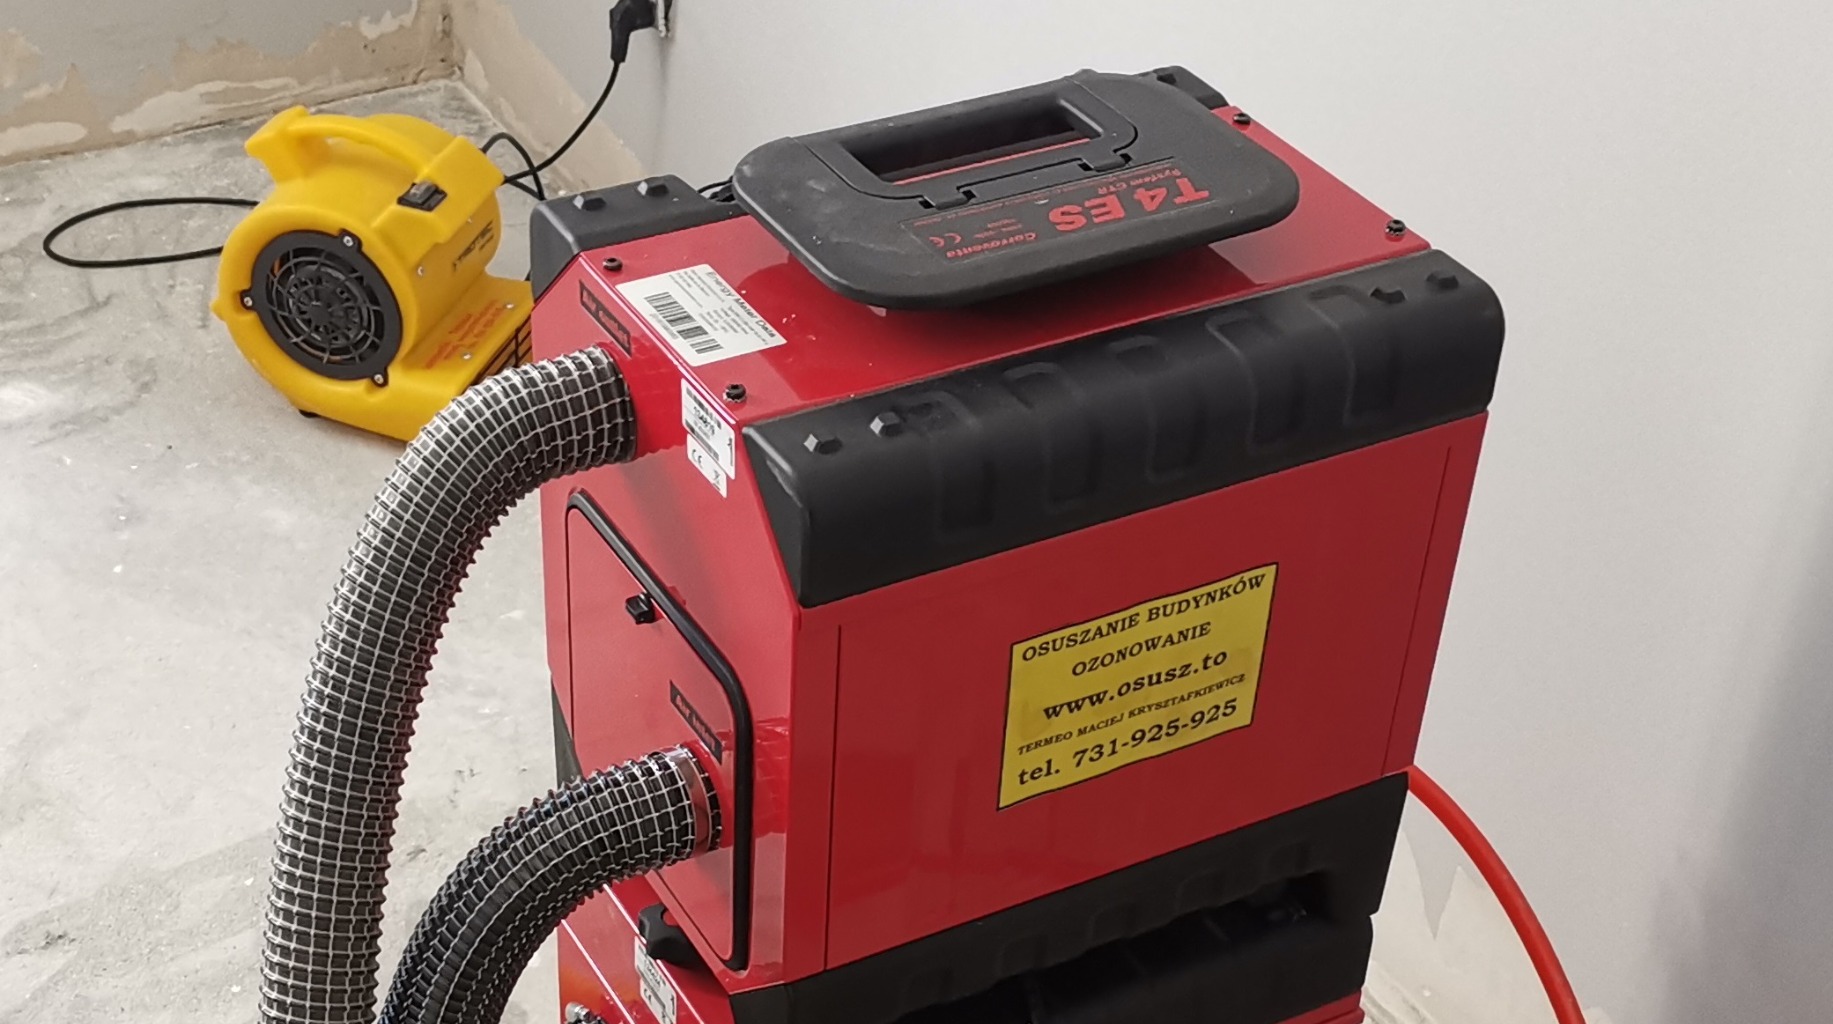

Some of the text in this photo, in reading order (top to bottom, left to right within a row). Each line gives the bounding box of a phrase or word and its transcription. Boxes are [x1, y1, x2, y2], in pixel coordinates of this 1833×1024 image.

[1048, 193, 1127, 232] ES
[1133, 177, 1211, 213] T4
[946, 231, 1037, 258] Corroventa
[705, 271, 735, 297] Energy
[755, 320, 776, 337] Data
[1021, 573, 1266, 662] OSUSZANIE BUDYNKÓW
[1071, 621, 1212, 677] OZONOWANIE
[1017, 673, 1246, 756] TERMEO MACIEJ KRYSZTAFKIEWICZ
[1042, 650, 1228, 721] www.osusz.to
[1017, 697, 1238, 786] tel. 731-925-925
